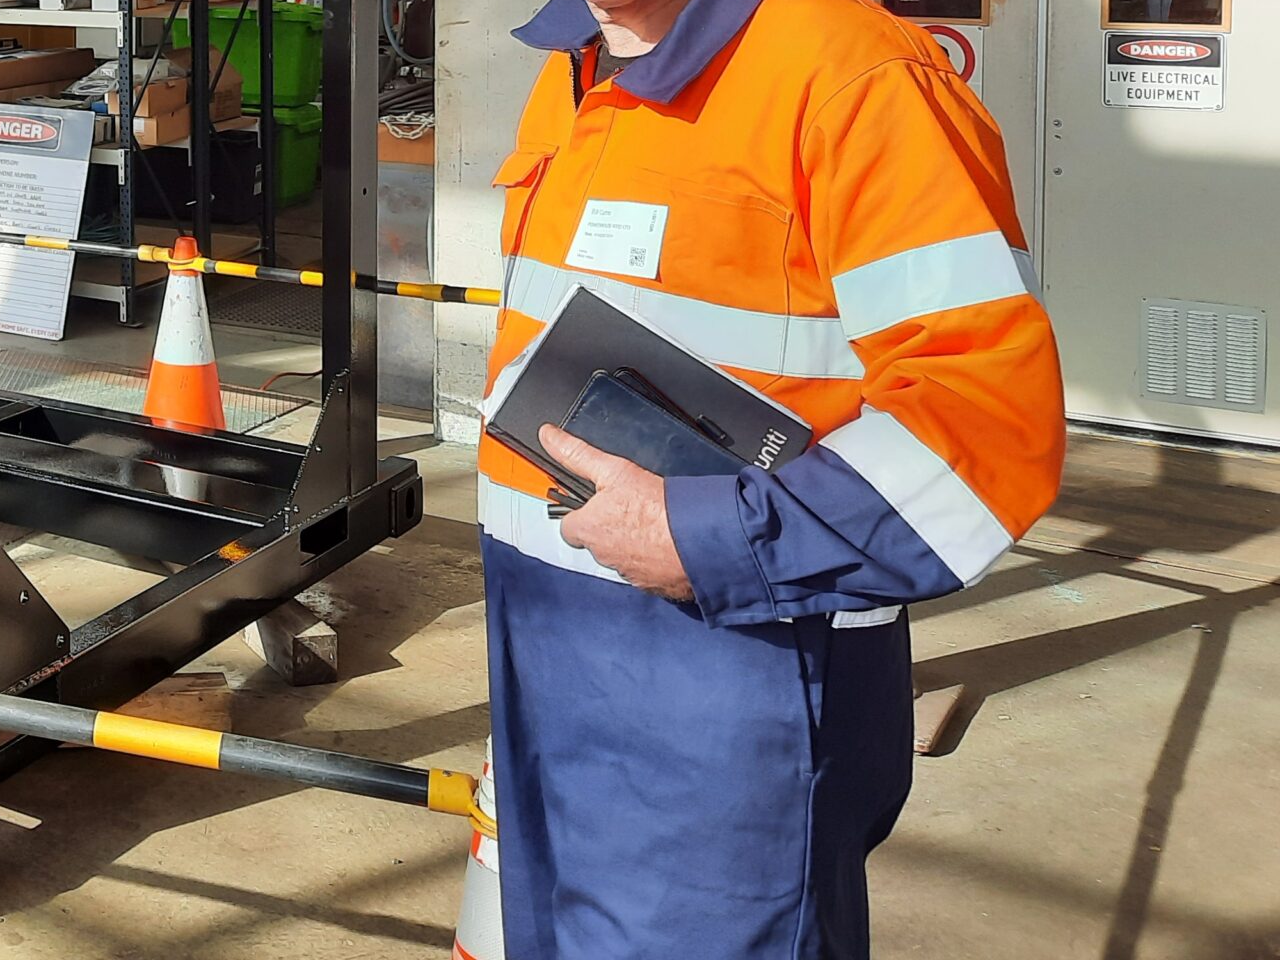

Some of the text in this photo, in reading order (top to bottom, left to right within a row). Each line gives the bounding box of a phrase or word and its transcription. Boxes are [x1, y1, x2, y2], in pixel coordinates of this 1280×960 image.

[1130, 44, 1197, 57] DANGER
[1110, 71, 1219, 86] LIVE ELECTRICAL
[1127, 88, 1200, 102] EQUIPMENT
